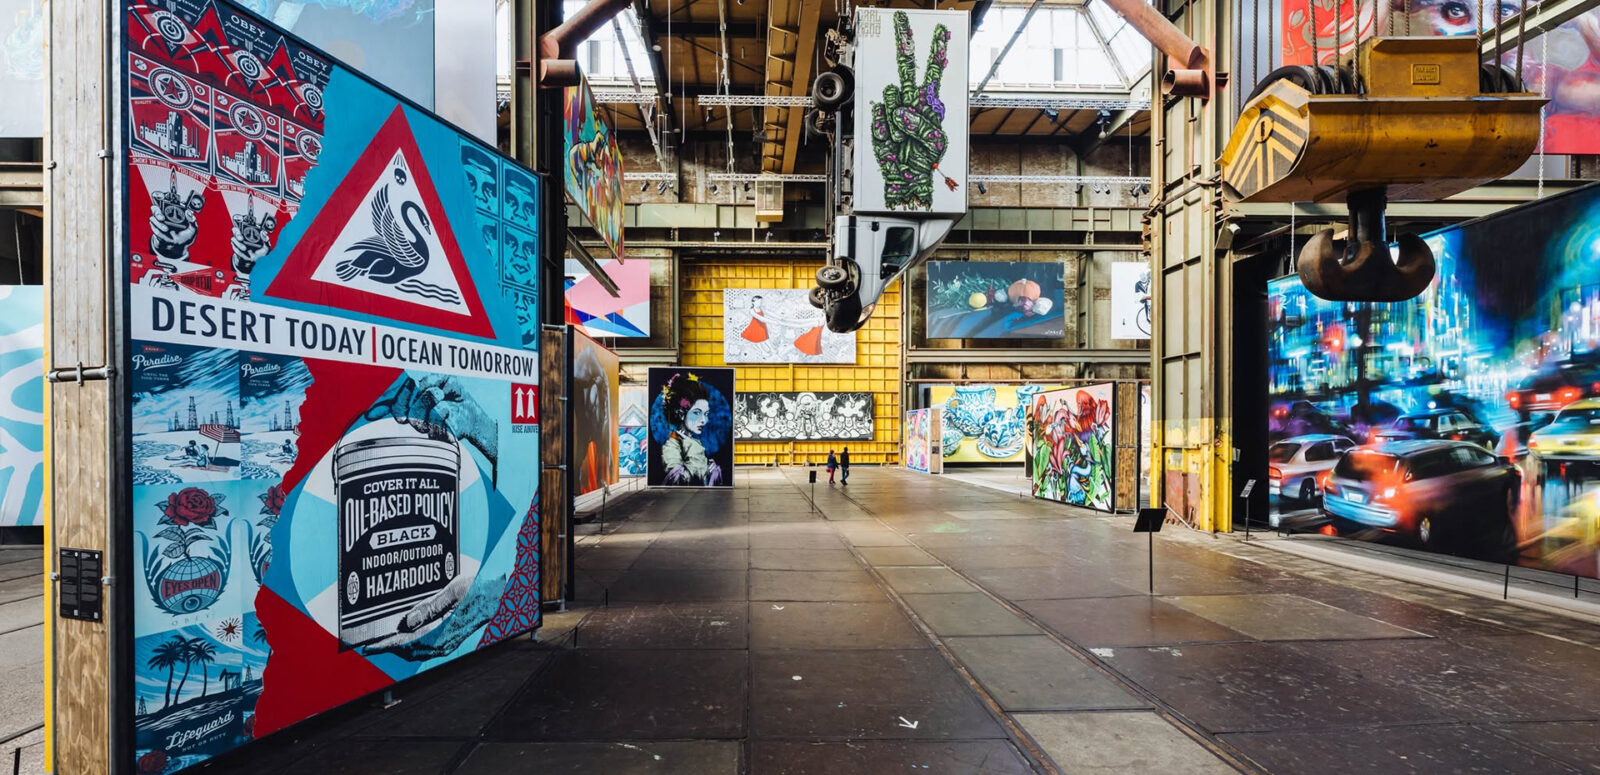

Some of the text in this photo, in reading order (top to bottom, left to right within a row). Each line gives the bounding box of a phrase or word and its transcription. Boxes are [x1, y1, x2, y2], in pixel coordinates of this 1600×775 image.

[231, 15, 265, 37] OBEY
[298, 51, 327, 71] OBEY
[192, 104, 208, 115] OBEY
[152, 296, 533, 377] DESERT TODAY OCEAN TOMORROW
[132, 354, 182, 371] Paradise
[241, 363, 280, 378] Paradise
[364, 478, 440, 495] COVER IT ALL
[345, 491, 455, 552] OIL-BASED POLICY
[377, 527, 431, 546] BLACK
[362, 544, 443, 570] INDOOR/OUTDOOR
[165, 572, 217, 597] EYES OPEN
[366, 561, 441, 599] HAZARDOUS
[165, 710, 234, 751] Lifeguard
[182, 744, 196, 752] NOT
